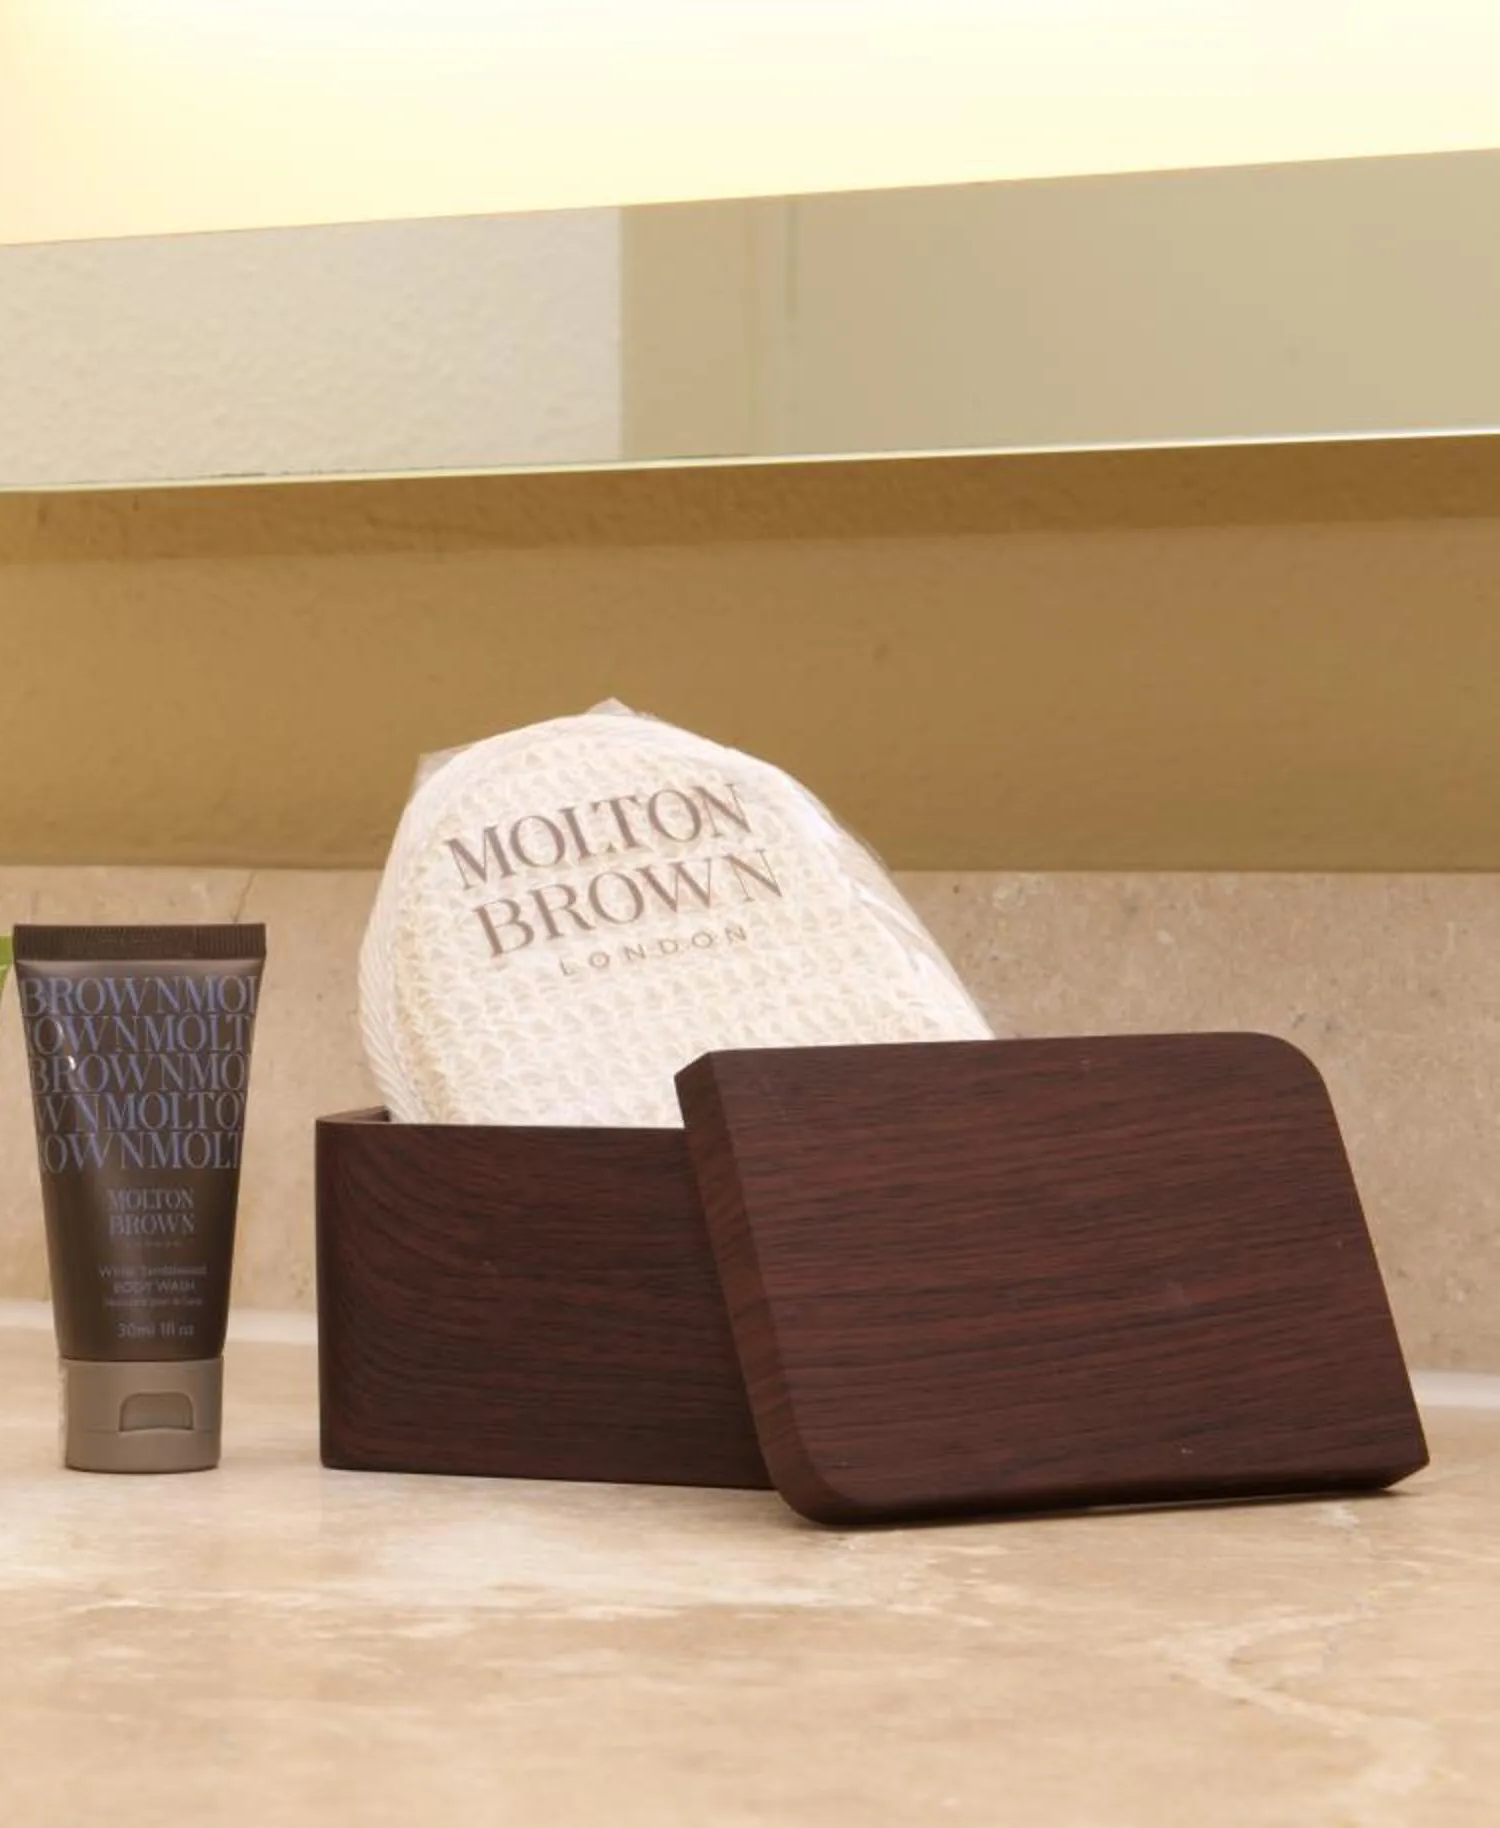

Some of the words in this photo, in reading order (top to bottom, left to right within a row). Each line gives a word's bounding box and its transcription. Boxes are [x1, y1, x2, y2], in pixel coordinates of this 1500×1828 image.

[445, 783, 751, 890] MOLTON
[473, 848, 782, 957] BROWN
[561, 924, 747, 976] LONDON
[107, 1187, 194, 1211] MOLTON
[109, 1213, 196, 1236] BROWN
